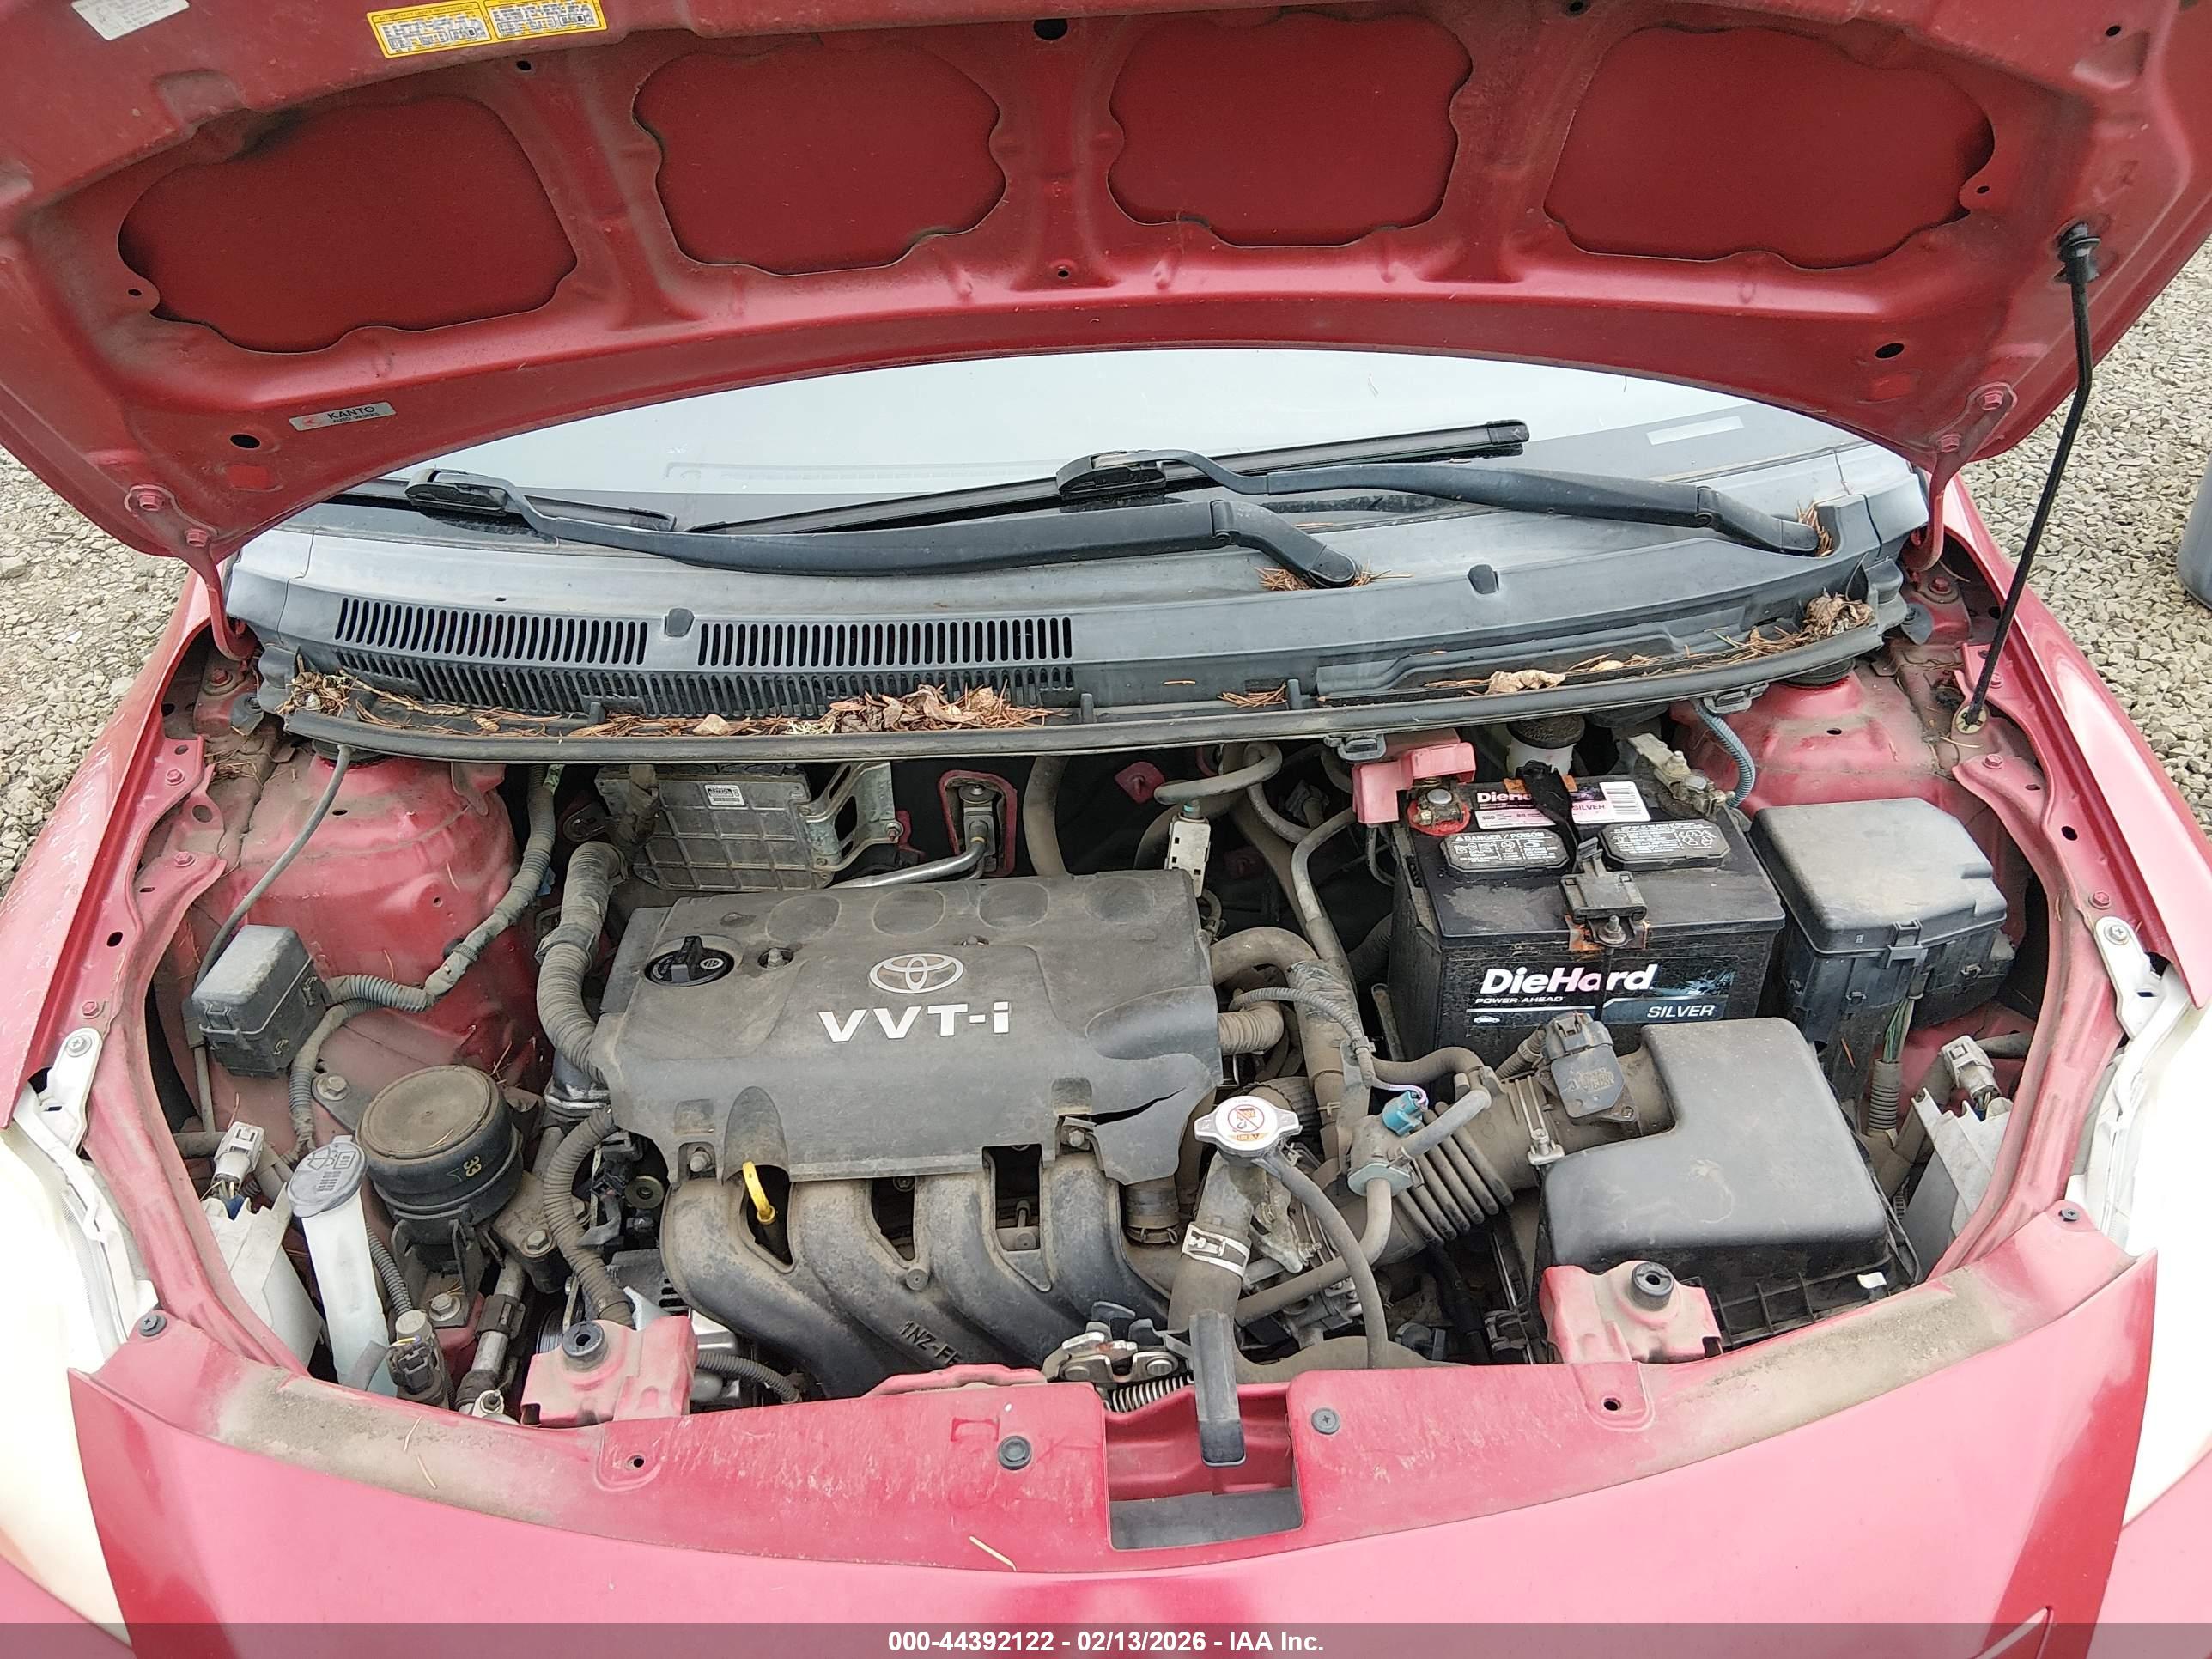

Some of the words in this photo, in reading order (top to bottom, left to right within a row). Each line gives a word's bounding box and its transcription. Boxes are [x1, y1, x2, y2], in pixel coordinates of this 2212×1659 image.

[327, 406, 375, 419] KANTO
[1480, 963, 1659, 995] DieHard
[817, 1000, 1010, 1043] VVT-i
[1647, 1005, 1716, 1018] SILVER
[463, 1155, 482, 1177] 33
